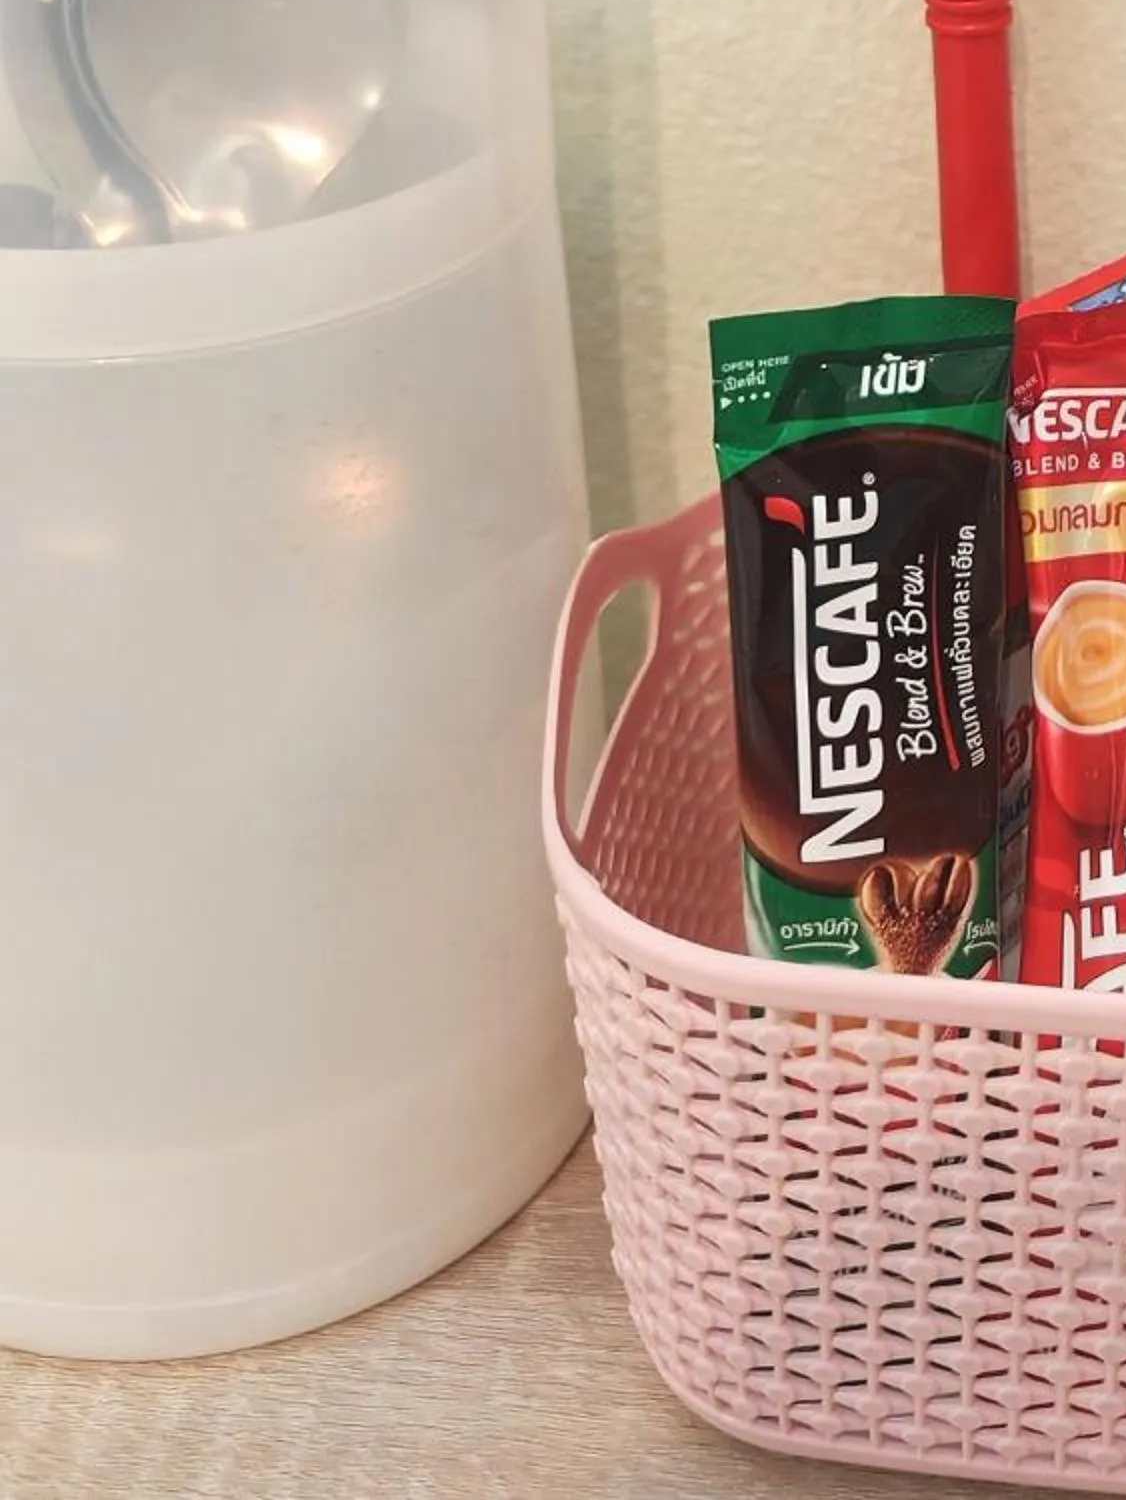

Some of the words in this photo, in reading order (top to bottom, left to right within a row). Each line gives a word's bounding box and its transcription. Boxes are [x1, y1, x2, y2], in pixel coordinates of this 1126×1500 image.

[859, 352, 927, 398] เข้ม
[1012, 455, 1080, 477] BLEND
[1087, 452, 1102, 471] &
[893, 644, 928, 670] &
[896, 676, 938, 763] Blend
